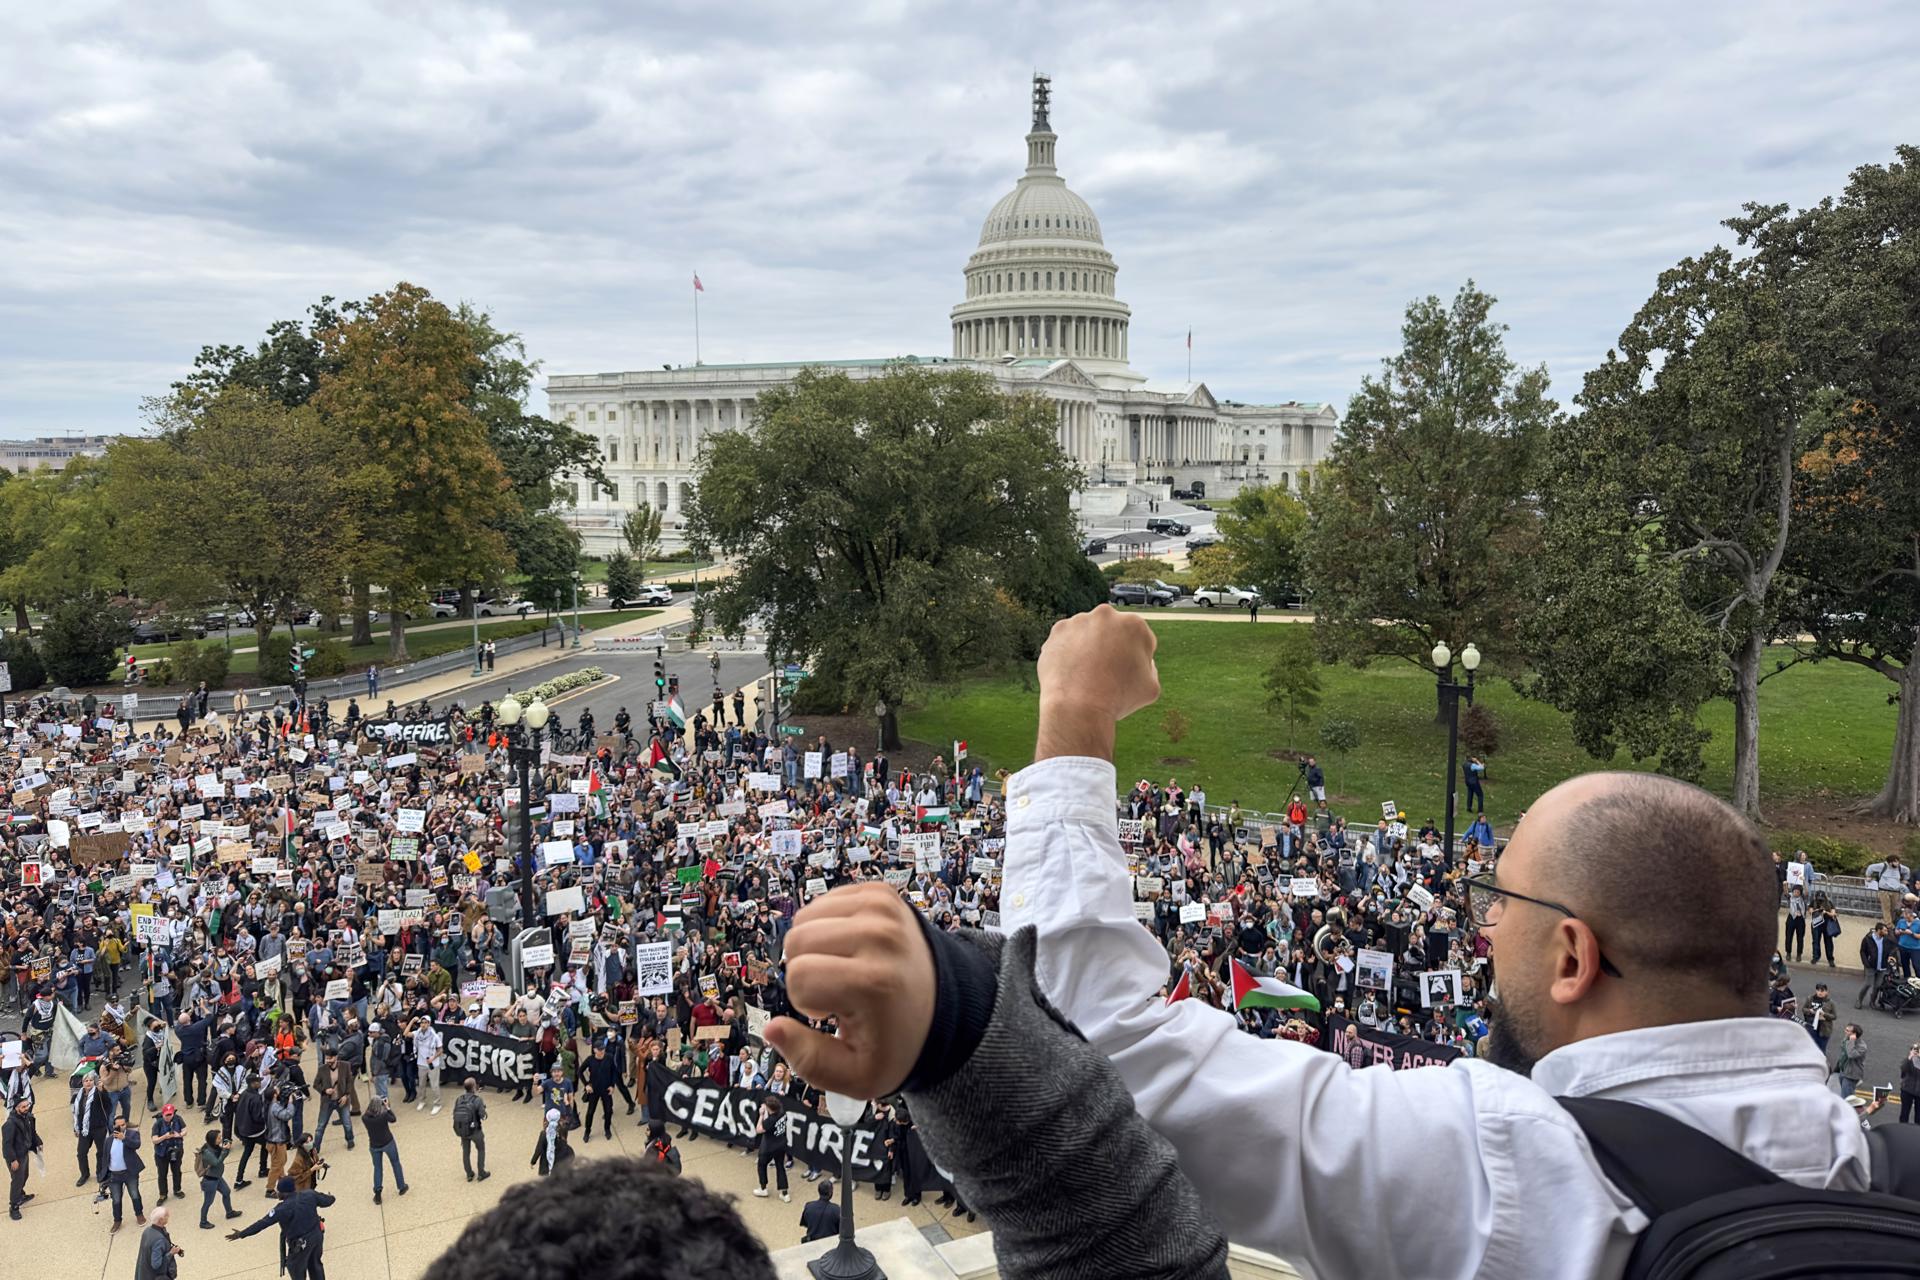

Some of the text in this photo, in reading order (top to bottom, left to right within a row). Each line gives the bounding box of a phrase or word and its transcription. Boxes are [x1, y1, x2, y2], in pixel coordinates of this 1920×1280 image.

[365, 720, 450, 742] CESEFIRE.
[153, 917, 168, 926] THE
[139, 925, 161, 934] SIEGE
[151, 934, 169, 943] GAZA
[1428, 974, 1452, 993] GAZA
[663, 1080, 885, 1172] CEASFIRE.
